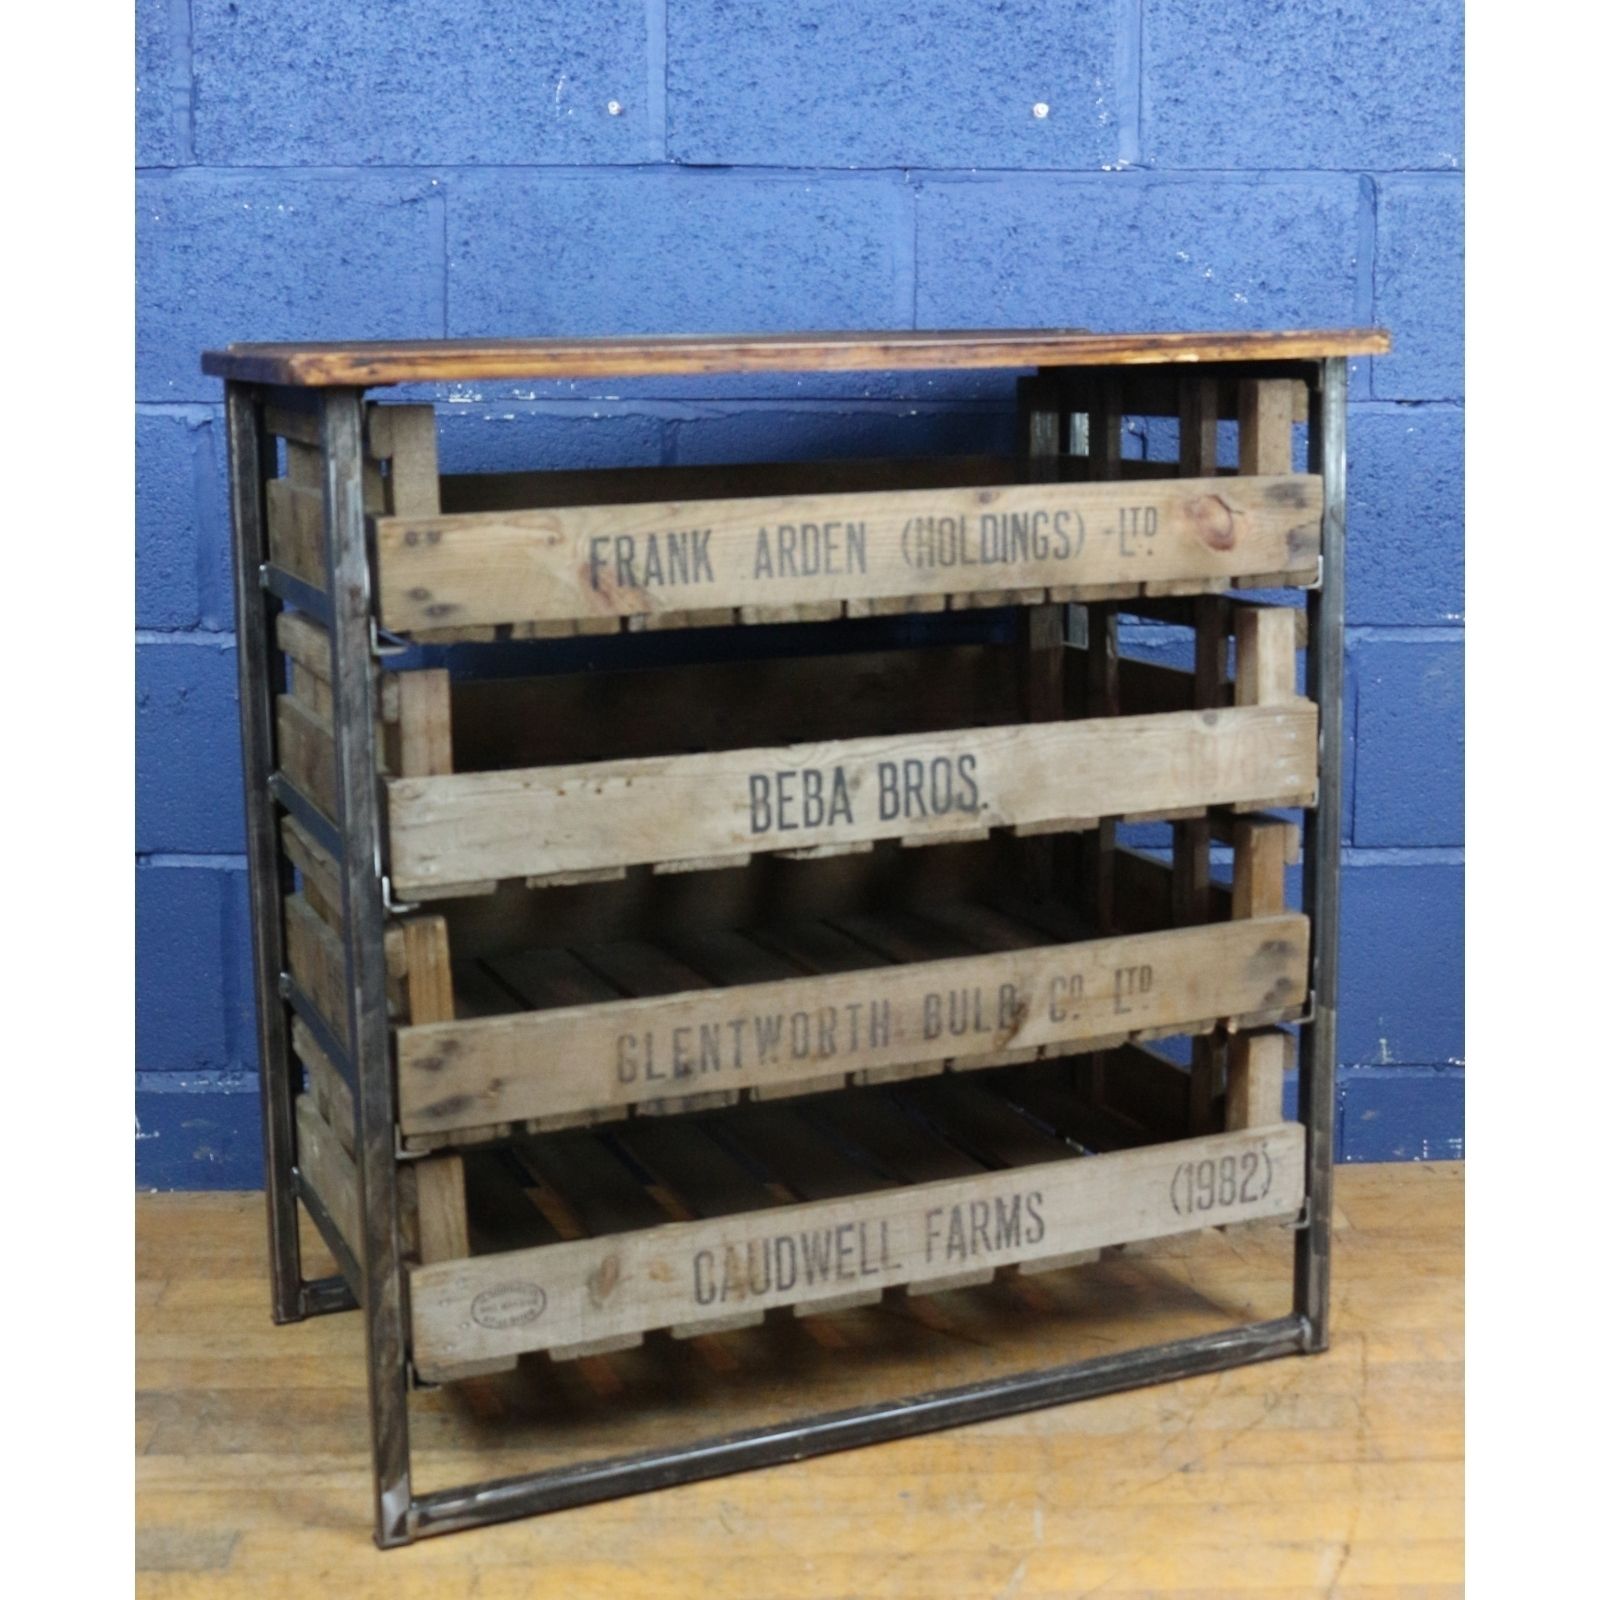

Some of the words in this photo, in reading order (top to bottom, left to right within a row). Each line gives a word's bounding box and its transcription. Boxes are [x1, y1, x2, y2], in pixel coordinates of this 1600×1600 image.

[589, 530, 714, 590] FRANK
[753, 522, 867, 579] ARDEN
[901, 510, 1086, 568] (HOLDINGS)
[749, 766, 854, 834] BEBA
[877, 754, 989, 822] BROS.
[616, 999, 891, 1085] GLENTWORTH
[923, 983, 1018, 1041] BULB
[693, 1220, 903, 1307] CAUDWELL
[924, 1191, 1046, 1264] FARMS
[1170, 1143, 1273, 1217] (1982)
